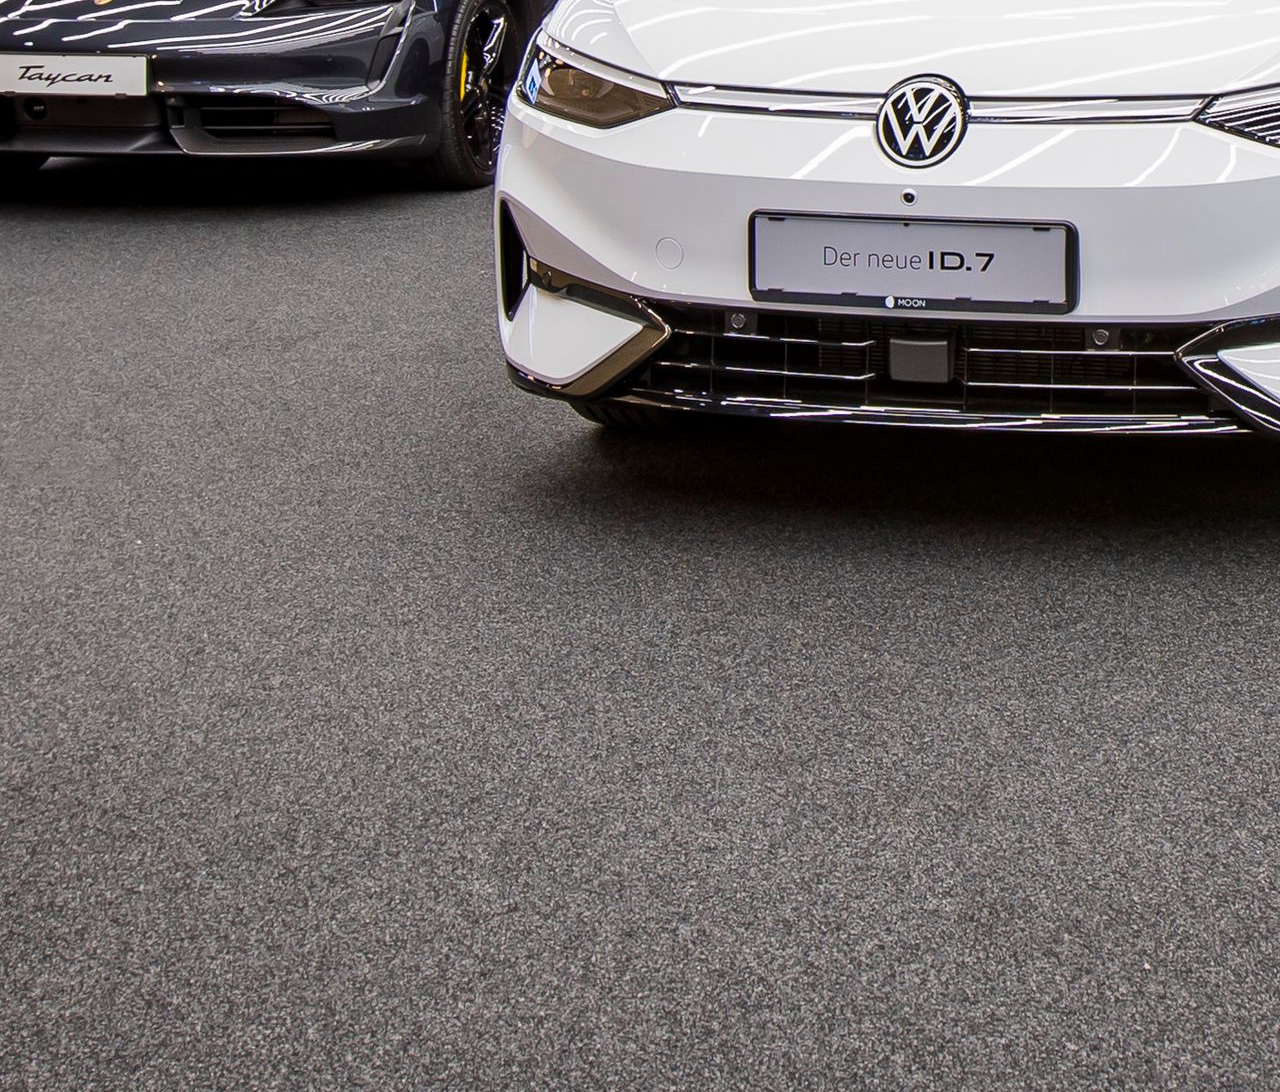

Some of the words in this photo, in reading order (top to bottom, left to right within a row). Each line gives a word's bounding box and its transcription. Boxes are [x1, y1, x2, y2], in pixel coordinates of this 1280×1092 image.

[18, 65, 113, 88] Taycan
[823, 246, 860, 267] Der
[867, 252, 922, 270] neue
[928, 250, 995, 272] ID.7
[897, 299, 926, 307] MOON
